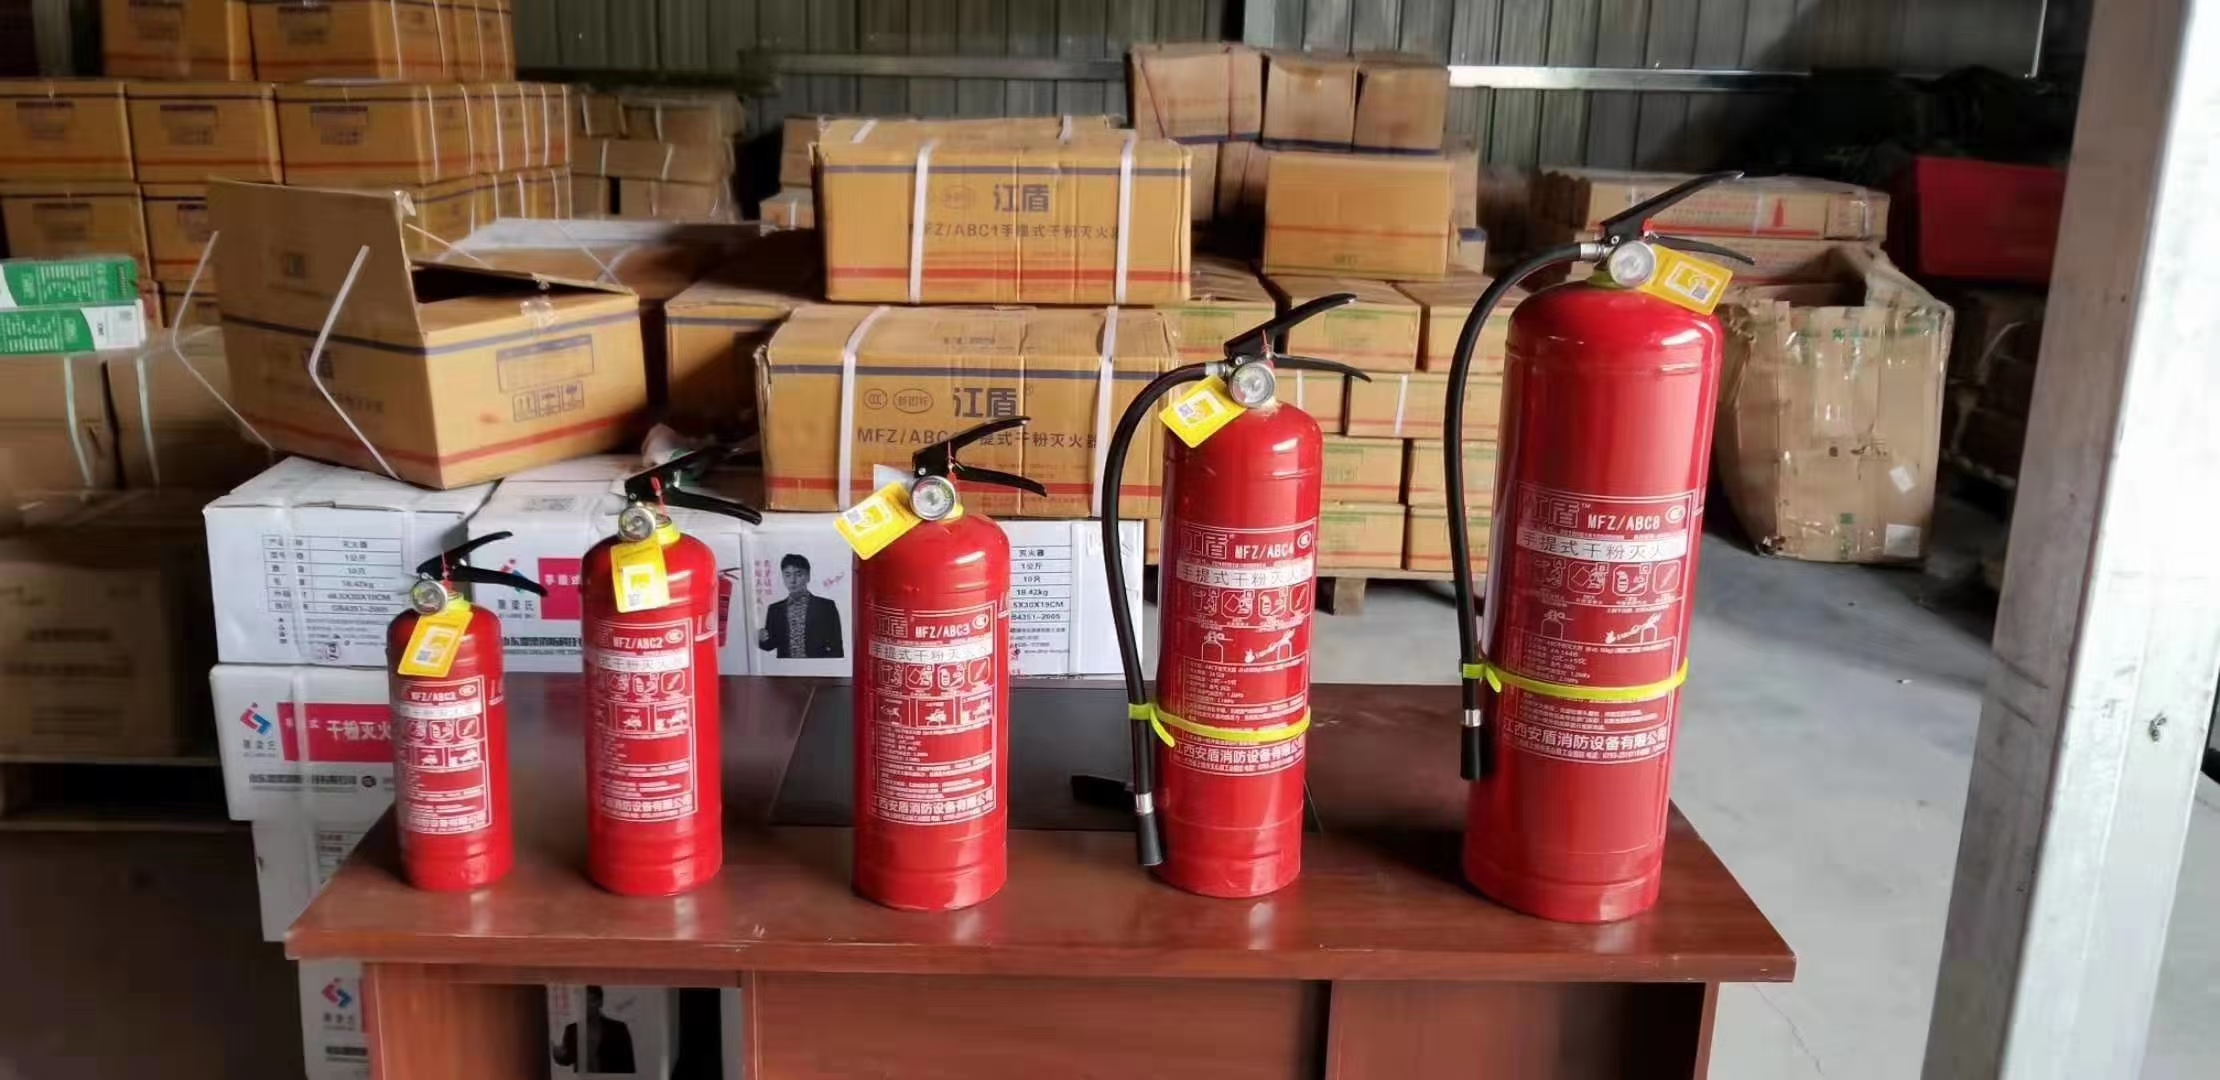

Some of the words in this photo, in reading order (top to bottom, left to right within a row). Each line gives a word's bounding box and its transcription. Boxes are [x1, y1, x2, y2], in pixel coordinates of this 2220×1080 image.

[994, 184, 1049, 213] 江盾
[953, 387, 1017, 418] 江盾
[1588, 514, 1660, 531] MFZ/ABC8
[1235, 545, 1294, 559] MFZ/ABC4
[915, 623, 970, 638] MFZ/ABC3
